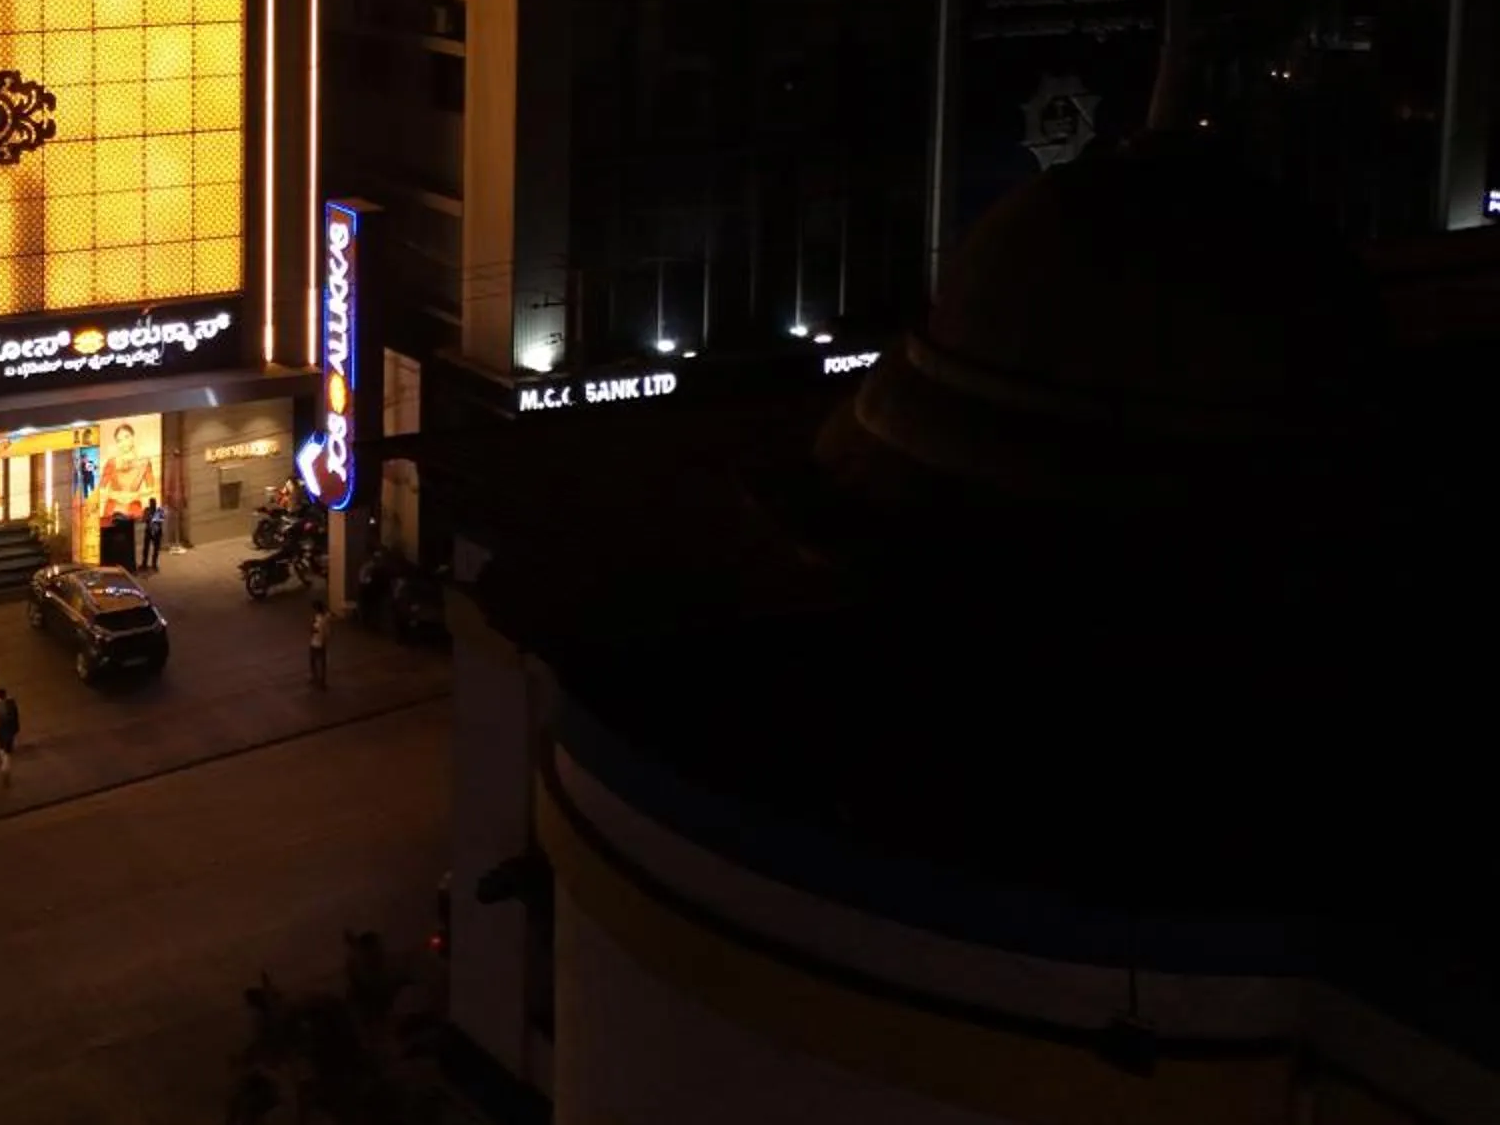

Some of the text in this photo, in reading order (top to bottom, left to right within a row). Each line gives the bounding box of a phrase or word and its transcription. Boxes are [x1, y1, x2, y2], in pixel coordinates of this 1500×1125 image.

[327, 223, 349, 482] JOS ALUKKAS
[643, 372, 677, 396] LTD
